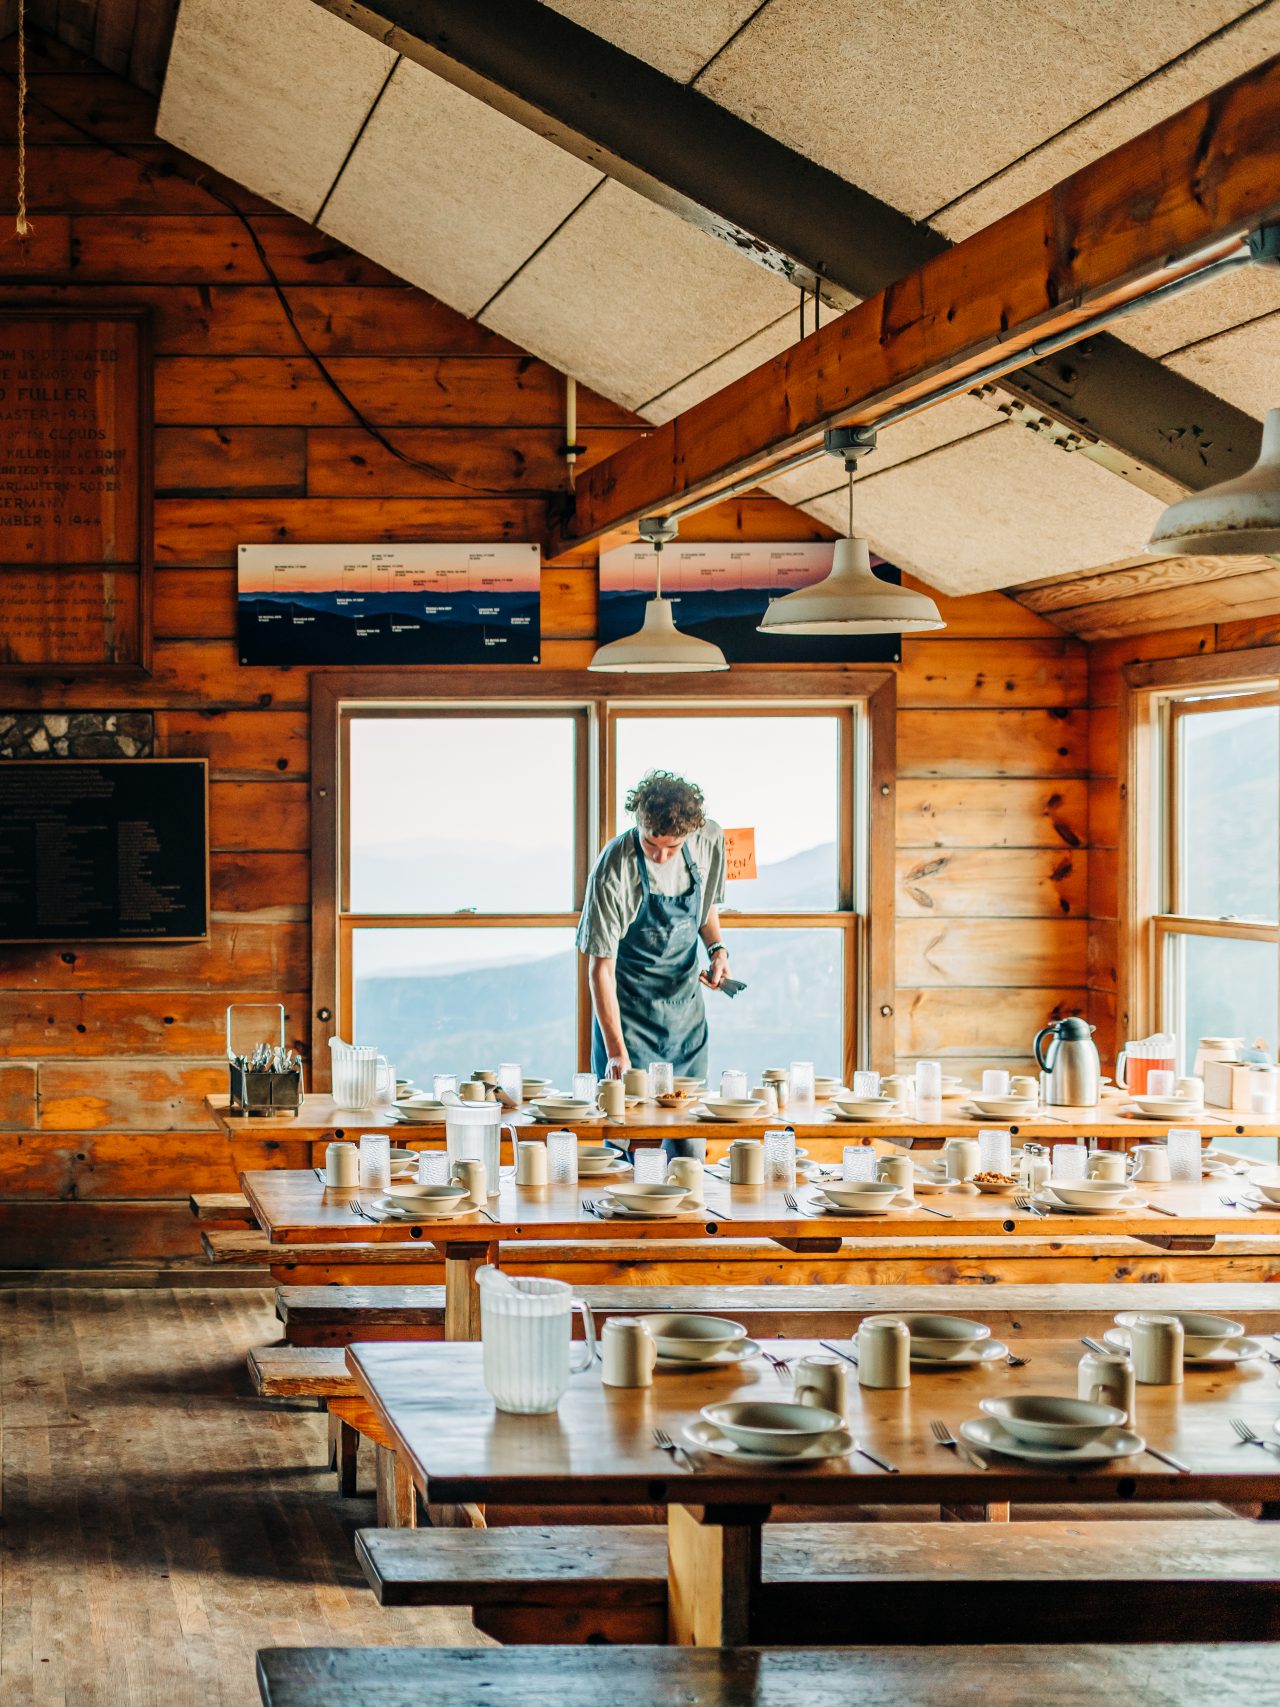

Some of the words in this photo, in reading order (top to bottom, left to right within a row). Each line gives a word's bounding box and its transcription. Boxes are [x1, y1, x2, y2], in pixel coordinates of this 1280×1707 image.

[22, 349, 35, 361] IS
[83, 369, 100, 380] OF
[17, 387, 89, 402] FULLER
[49, 428, 106, 440] CLOUDS
[7, 448, 51, 459] KILLED
